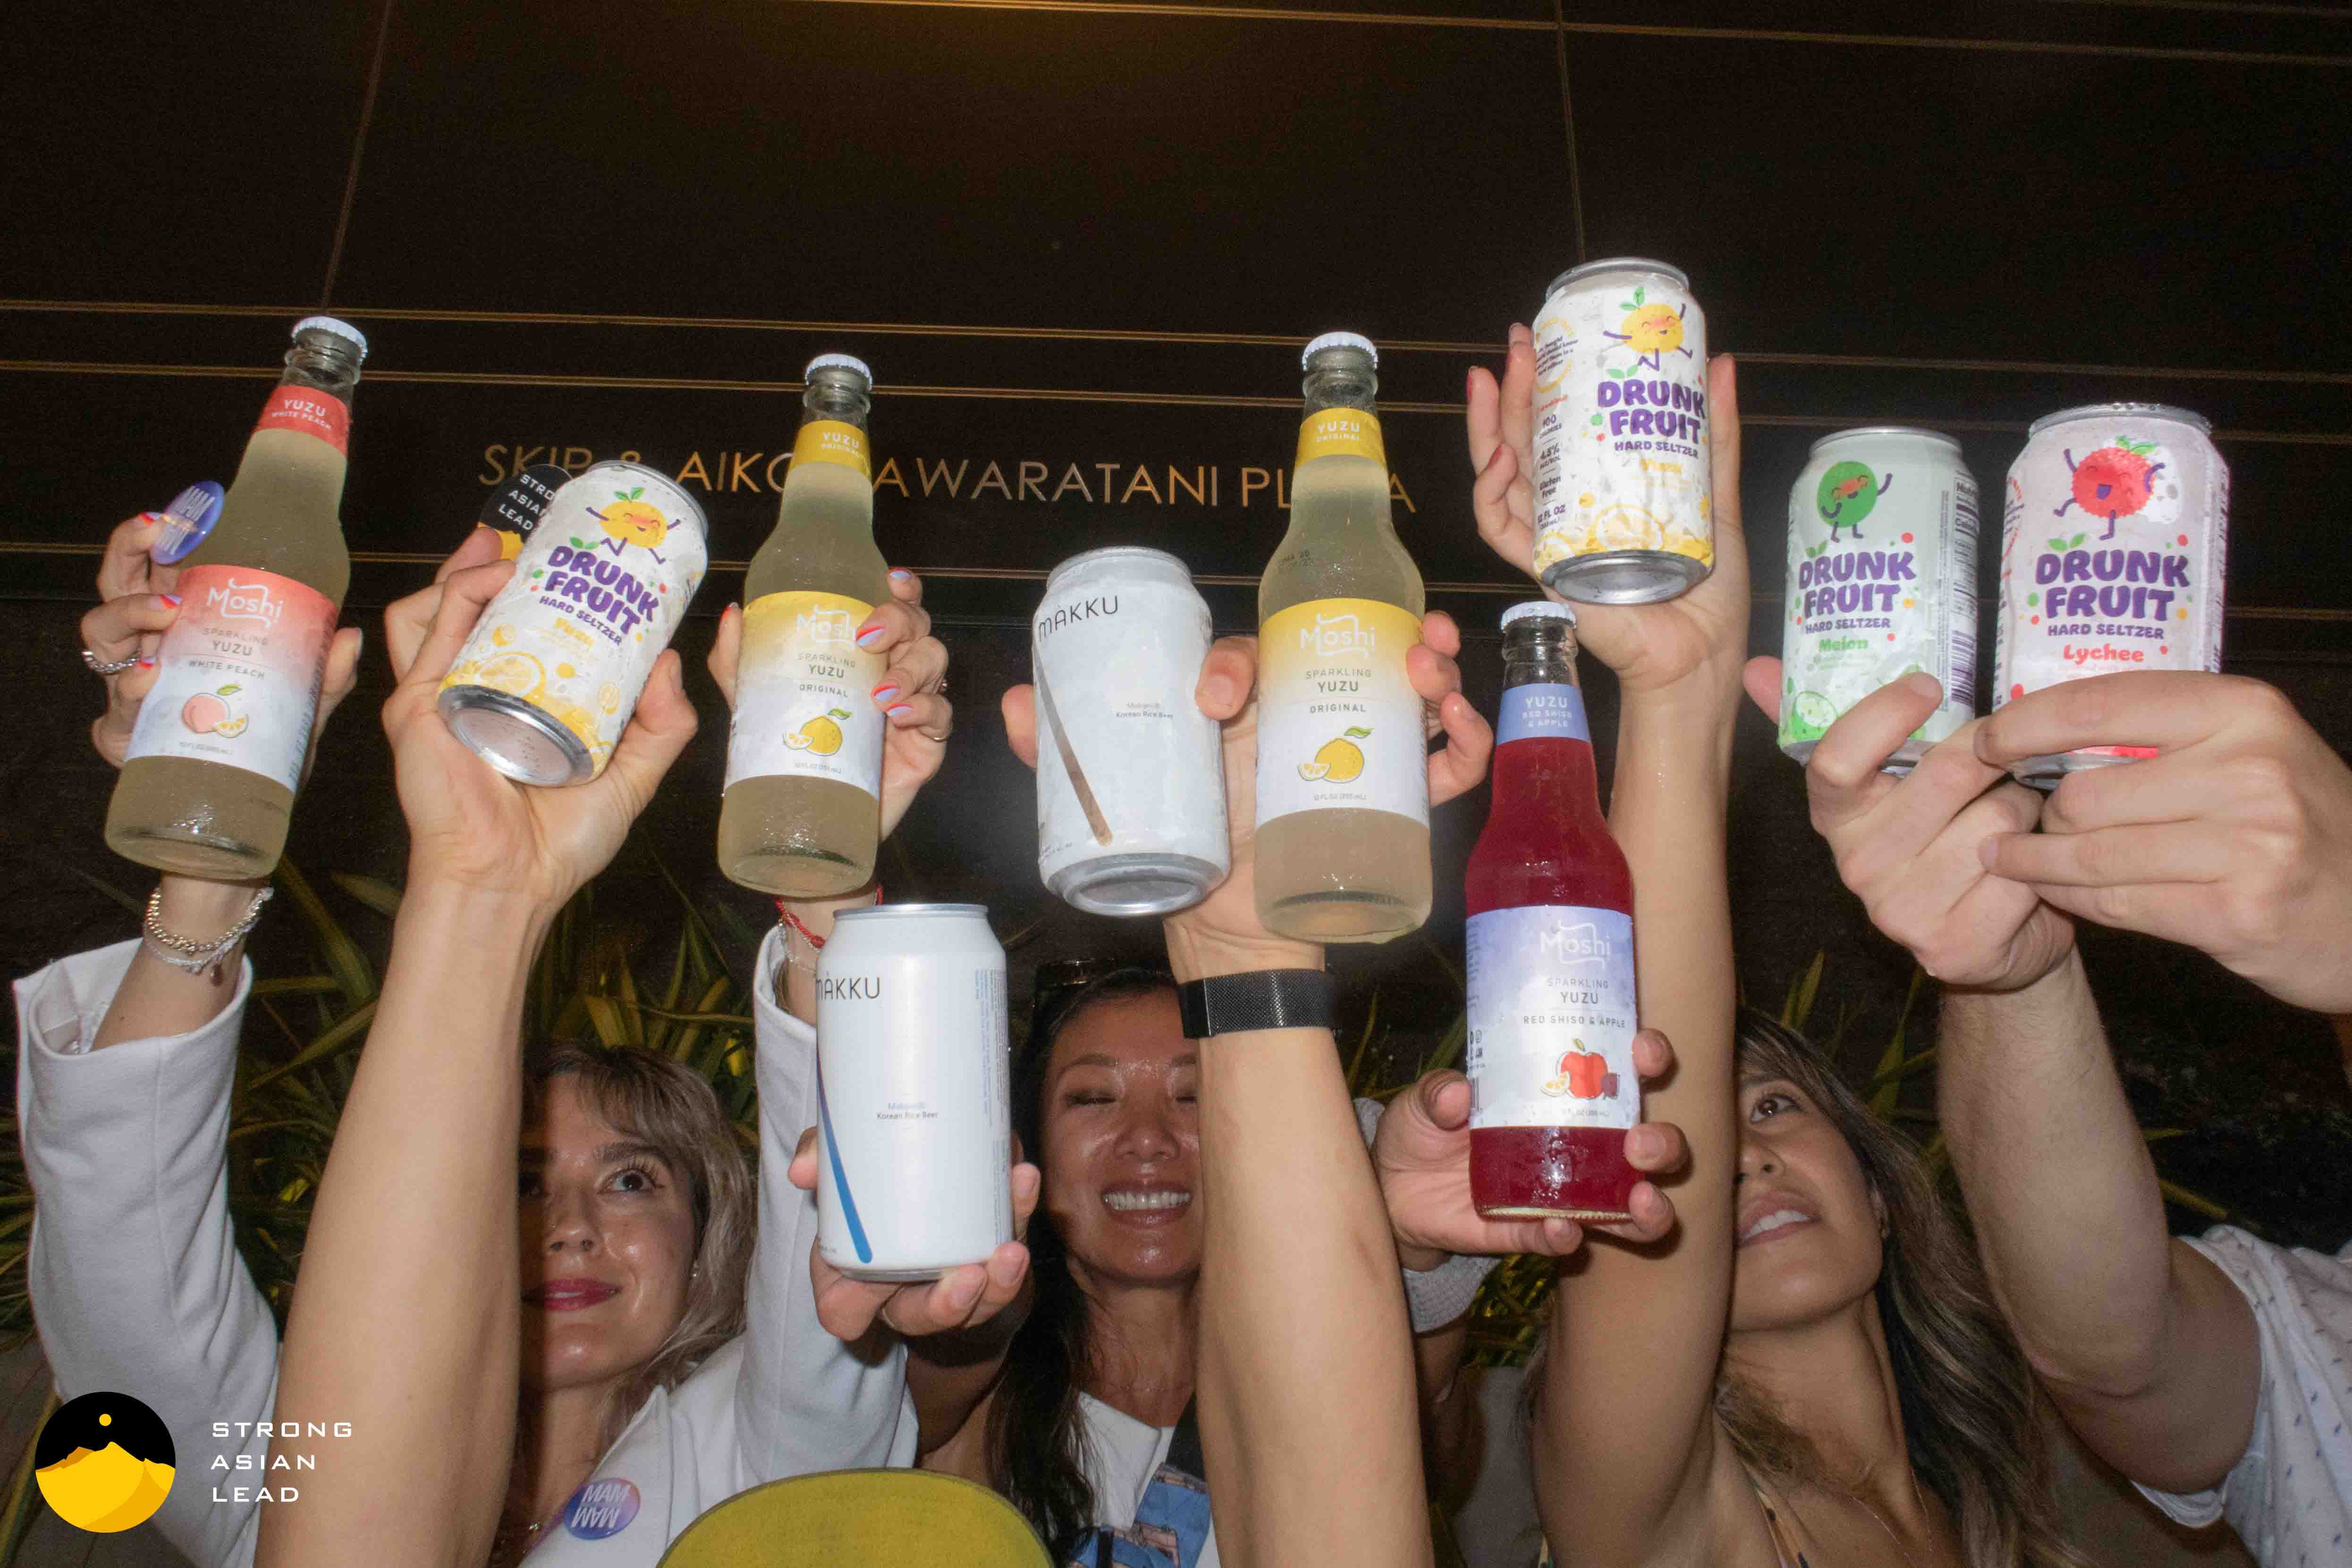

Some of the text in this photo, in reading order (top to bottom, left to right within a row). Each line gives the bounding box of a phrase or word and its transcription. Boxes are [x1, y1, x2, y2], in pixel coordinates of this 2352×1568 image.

[284, 399, 326, 416] YUZU
[1598, 379, 1705, 419] DRUNK
[1318, 421, 1360, 433] YUZU
[1610, 409, 1701, 444] FRUIT
[822, 432, 860, 449] YUZU
[1614, 441, 1698, 458] HARD SELTZER
[479, 444, 593, 485] SKIP
[873, 457, 1218, 507] AWARATANI
[1242, 467, 1416, 513] PLA
[499, 503, 533, 530] LEAD
[1799, 551, 1916, 589] DRUNK
[2036, 550, 2190, 587] DRUNK
[548, 546, 659, 622] DRUNK
[206, 577, 283, 627] Moshi
[545, 571, 641, 635] FRUIT
[1804, 584, 1901, 619] FRUIT
[2046, 585, 2174, 621] FRUIT
[540, 595, 575, 613] HARD
[576, 610, 623, 645] SELTZER
[1805, 618, 1891, 634] HARD SELTZER
[1300, 614, 1375, 658] Moshi
[2047, 624, 2165, 639] HARD SELTZER
[212, 640, 254, 656] YUZU
[1820, 635, 1868, 651] Melon
[798, 653, 856, 669] SPARKLING
[2064, 643, 2144, 665] Lychee
[188, 661, 265, 680] WHITE PEACH
[809, 663, 845, 678] YUZU
[1306, 668, 1372, 679] SPARKLING
[799, 683, 848, 698] ORIGINAL
[1318, 681, 1359, 693] YUZU
[1310, 703, 1366, 713] ORIGINAL
[1526, 696, 1568, 708] YUZU
[1538, 720, 1568, 728] APPLE
[1540, 920, 1610, 969] Moshi
[1548, 978, 1609, 989] SPARKLING
[1560, 992, 1599, 1004] YUZU
[1523, 1016, 1545, 1024] RED
[1550, 1016, 1584, 1024] SHISO
[1599, 1017, 1625, 1028] APPLE
